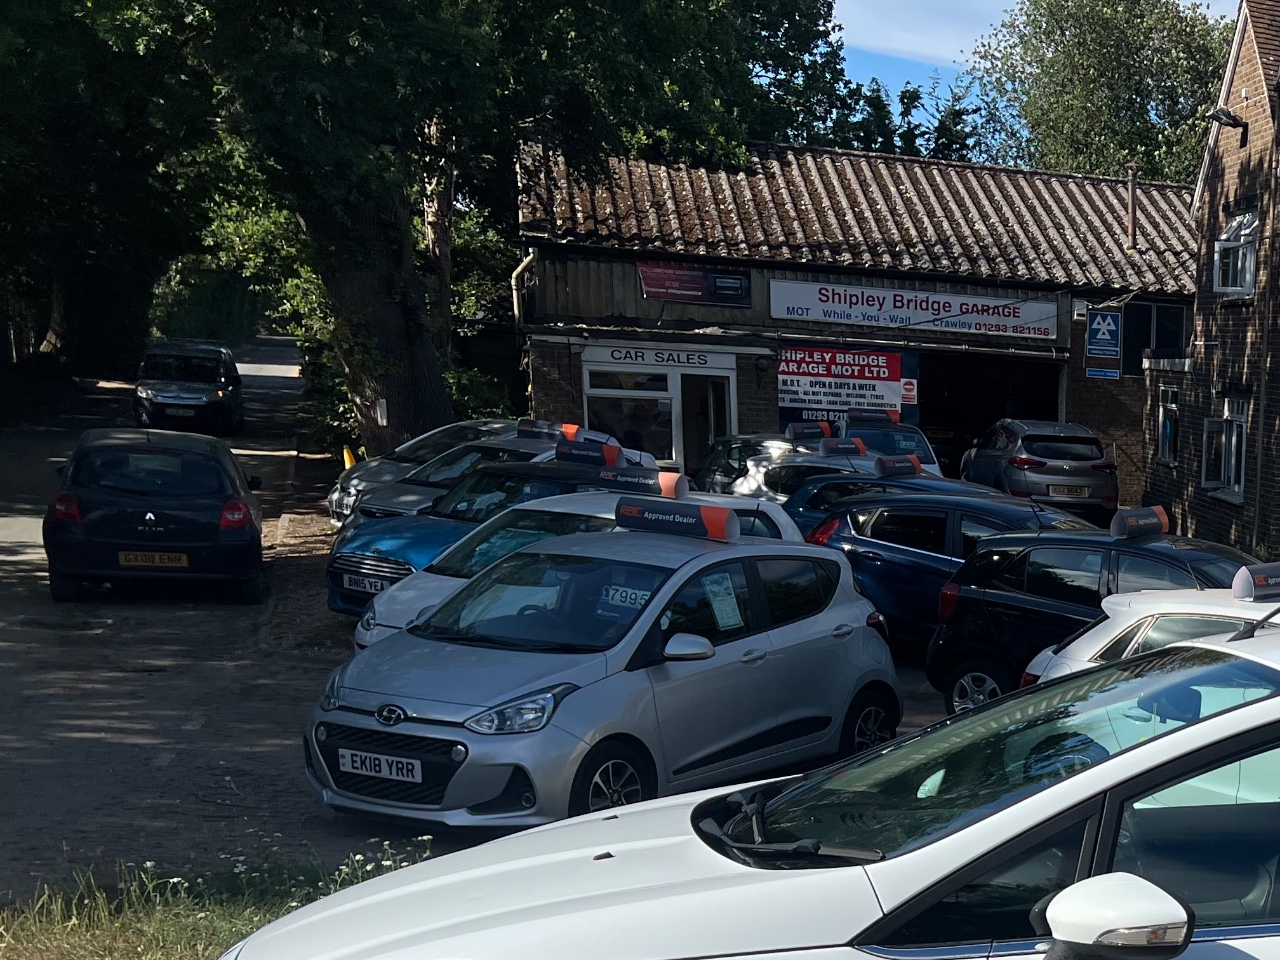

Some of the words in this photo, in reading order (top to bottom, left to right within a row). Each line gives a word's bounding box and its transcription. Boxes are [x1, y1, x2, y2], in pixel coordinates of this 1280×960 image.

[818, 287, 886, 311] Shipley
[893, 290, 952, 315] Bridge
[959, 302, 1021, 318] GARAGE
[786, 306, 811, 317] MOT
[823, 309, 852, 320] While
[860, 311, 880, 322] You
[889, 313, 911, 325] Wait
[932, 317, 973, 330] Crawley
[975, 322, 1007, 333] 01293
[1012, 325, 1050, 336] 821156
[610, 349, 645, 361] CAR
[654, 351, 708, 365] SALES
[780, 350, 833, 363] HIPLEY
[836, 352, 887, 366] BRIDGE
[779, 362, 828, 374] ARAGE
[831, 364, 861, 376] MOT
[865, 367, 889, 378] LTD
[809, 380, 827, 389] OPEN
[834, 382, 851, 390] DAYS
[858, 383, 876, 392] WEEK
[802, 410, 828, 420] 01293
[829, 411, 848, 420] 8211
[617, 475, 638, 483] Approved
[644, 511, 674, 522] Approved
[675, 514, 697, 524] Dealer
[348, 576, 366, 590] BN15
[351, 753, 382, 774] EK18
[386, 759, 415, 779] YRR
